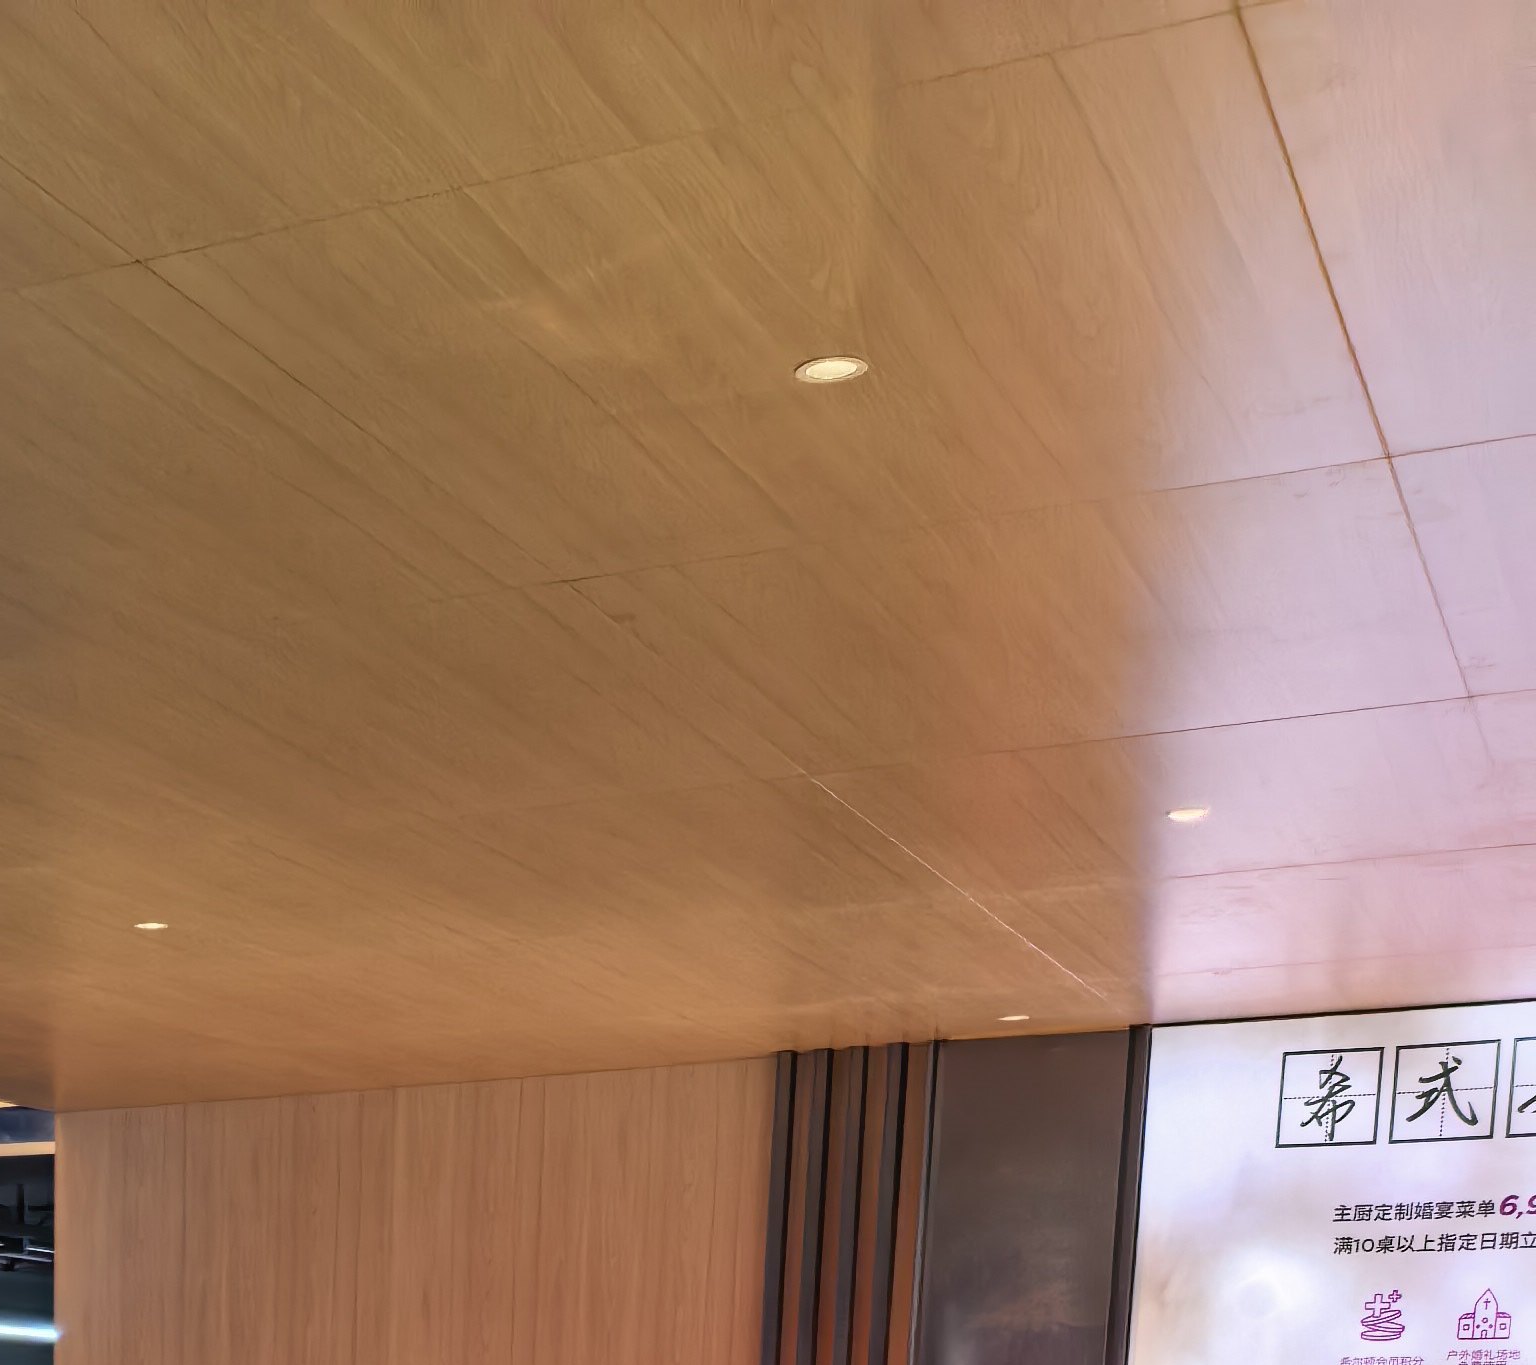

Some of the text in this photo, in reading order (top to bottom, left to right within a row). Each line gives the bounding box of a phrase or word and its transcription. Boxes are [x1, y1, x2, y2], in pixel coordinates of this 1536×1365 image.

[1300, 1055, 1536, 1141] 希式
[1332, 1200, 1496, 1223] 主厨定制婚宴菜单
